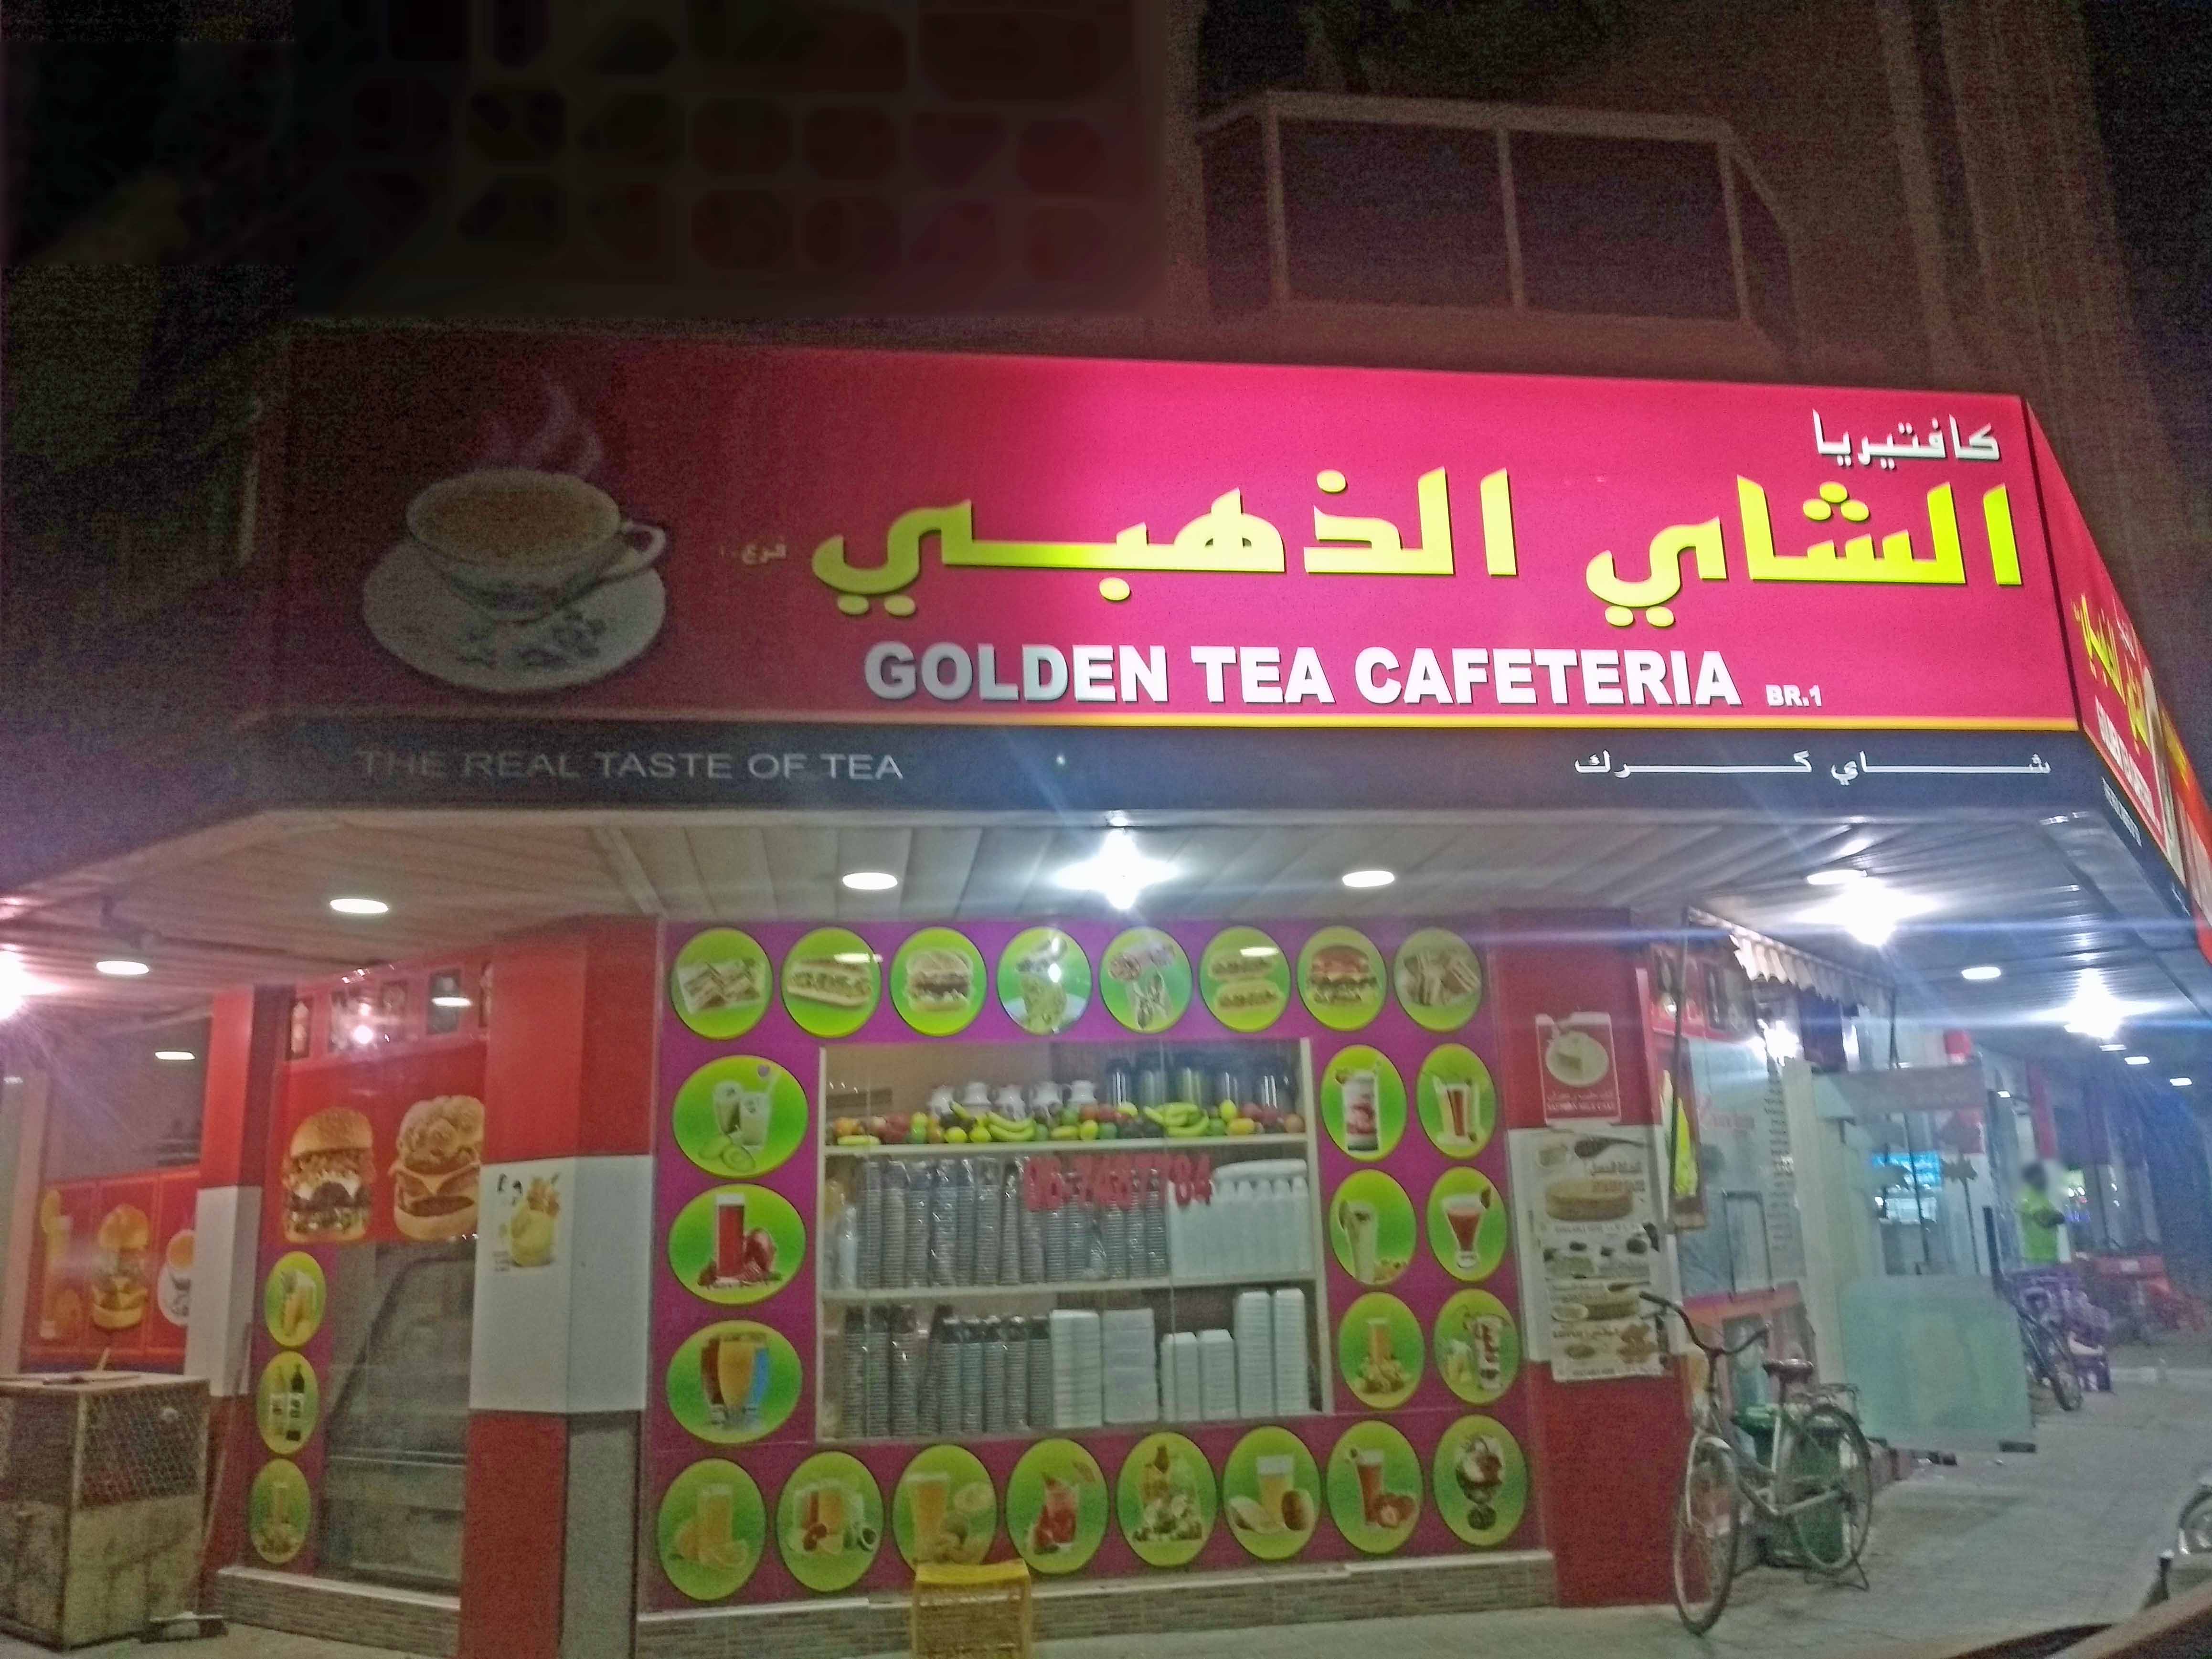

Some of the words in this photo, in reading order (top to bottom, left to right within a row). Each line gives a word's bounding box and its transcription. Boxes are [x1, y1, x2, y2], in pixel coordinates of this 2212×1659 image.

[1813, 409, 2001, 470] كافتيريا
[812, 466, 1518, 617] الذهبي
[1586, 474, 2023, 627] الشاي
[864, 642, 1169, 702] GOLDEN
[1190, 646, 1336, 703] TEA
[1354, 647, 1742, 705] CAFETERIA
[1766, 684, 1823, 708] BR.1
[356, 749, 444, 779] THE
[461, 750, 582, 779] REAL
[595, 752, 733, 780] TASTE
[746, 753, 812, 780] OF
[822, 753, 904, 781] TEA
[1574, 749, 1813, 779] كرك
[1830, 751, 2052, 786] شاي
